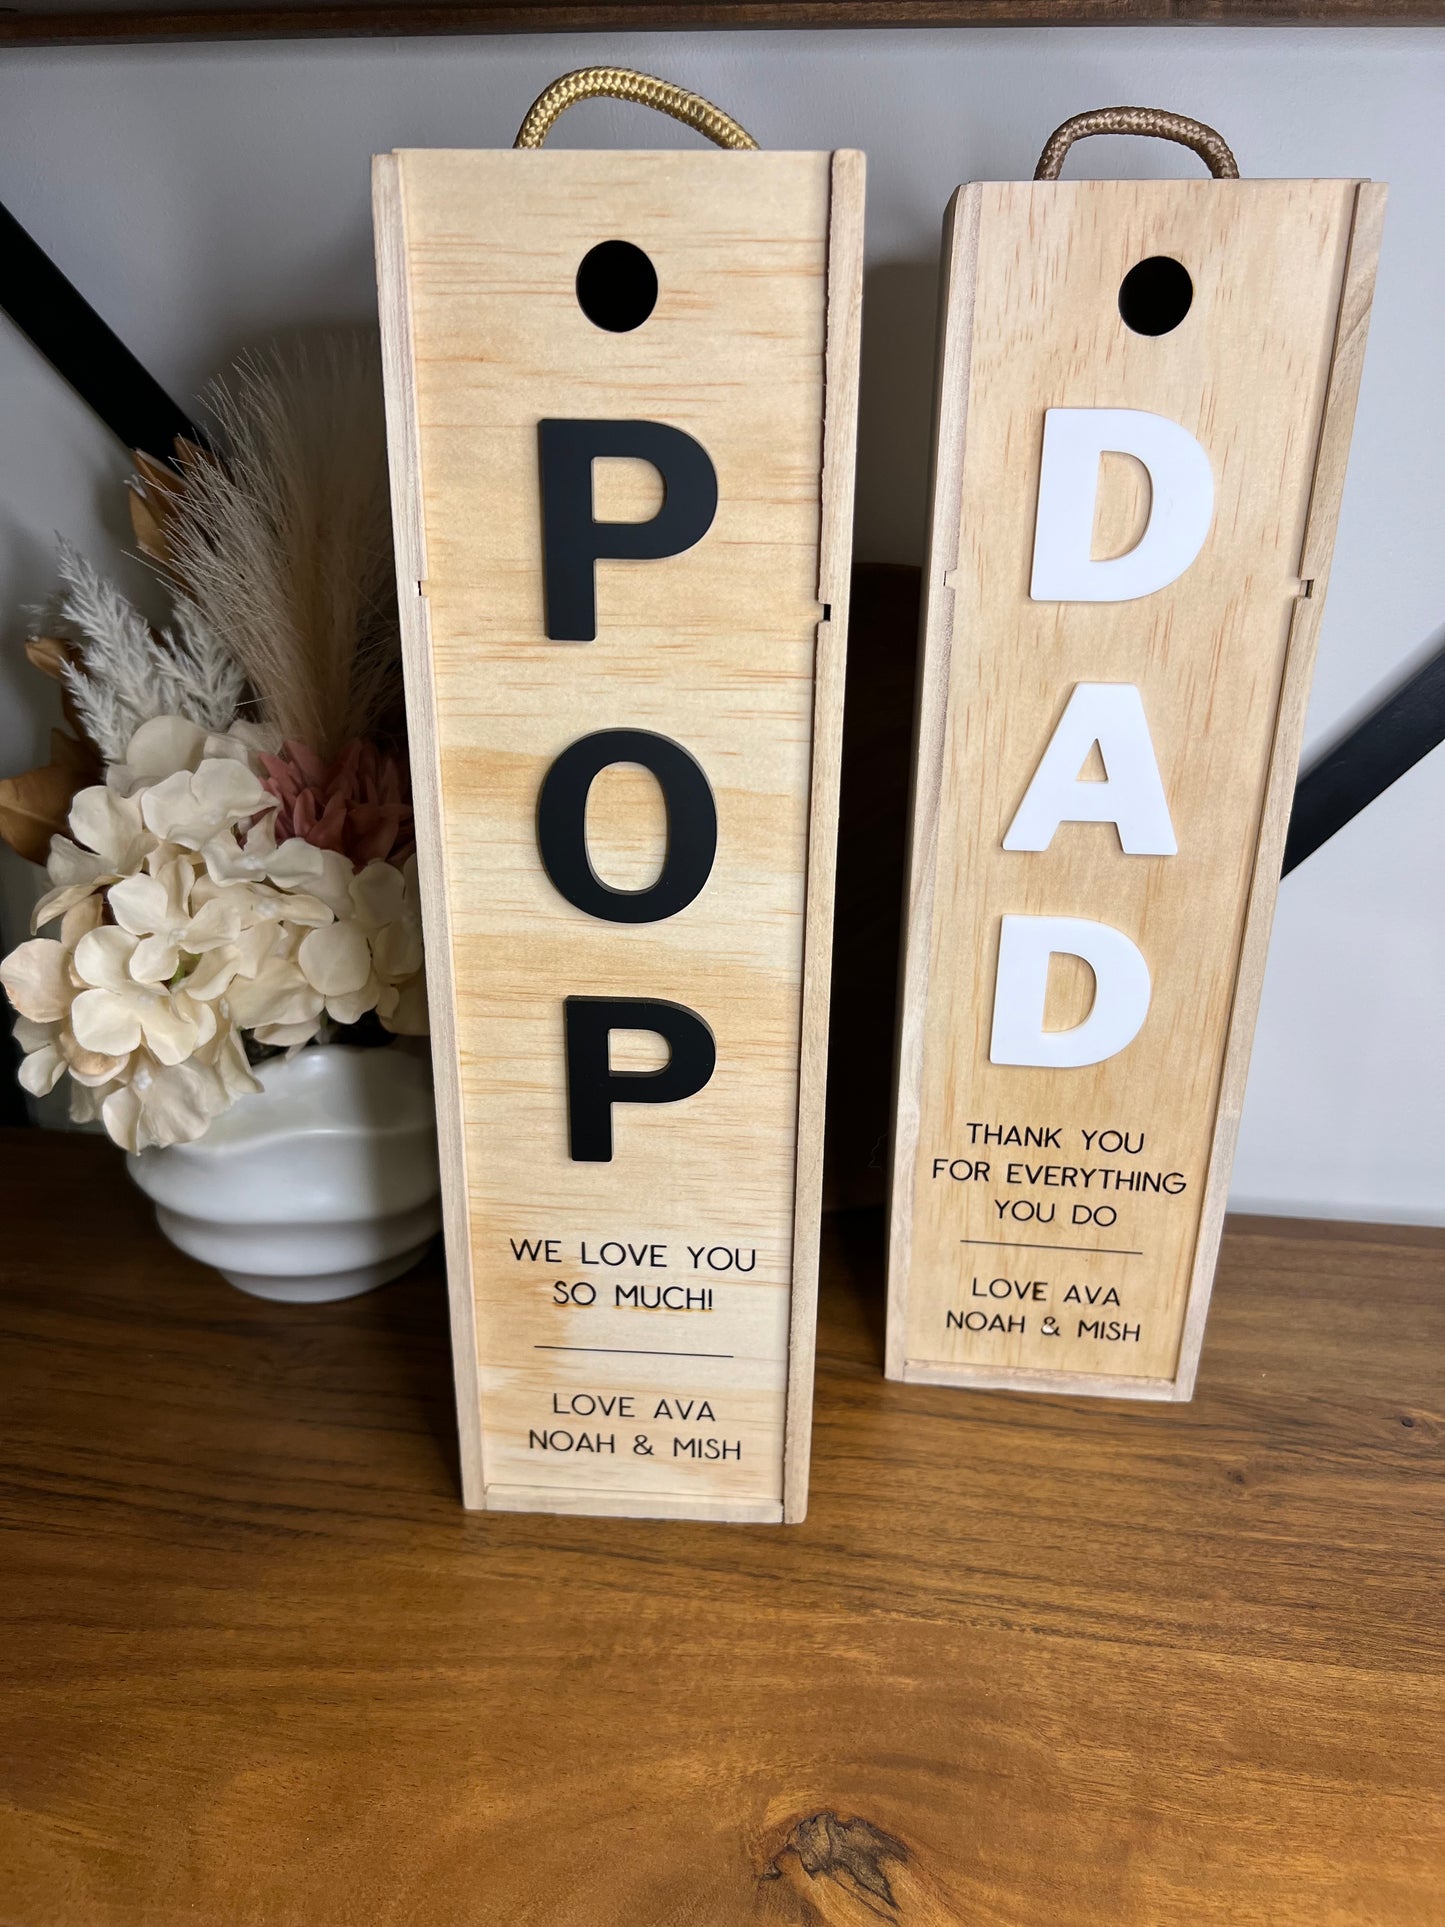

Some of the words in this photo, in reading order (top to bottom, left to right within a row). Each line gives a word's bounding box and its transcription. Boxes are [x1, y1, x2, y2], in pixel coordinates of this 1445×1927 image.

[991, 406, 1217, 1068] DAD
[536, 416, 719, 1163] POP
[967, 1122, 1063, 1148] THANK
[1081, 1129, 1145, 1154] YOU
[932, 1158, 990, 1182] FOR
[1006, 1163, 1187, 1194] EVERYTHING
[994, 1199, 1055, 1223] YOU
[1072, 1204, 1117, 1227] DO
[510, 1238, 562, 1263] WE
[581, 1241, 667, 1267] LOVE
[687, 1246, 756, 1272] YOU
[553, 1281, 596, 1306] SO
[615, 1284, 713, 1310] MUCH!
[972, 1277, 1049, 1301] LOVE
[1063, 1284, 1121, 1307] AVA
[946, 1310, 1025, 1333] NOAH
[1041, 1316, 1060, 1337] &
[1078, 1320, 1141, 1342] MISH
[553, 1393, 635, 1418] LOVE
[653, 1399, 716, 1422] AVA
[529, 1429, 615, 1454] NOAH
[633, 1434, 654, 1456] &
[673, 1437, 741, 1460] MISH
